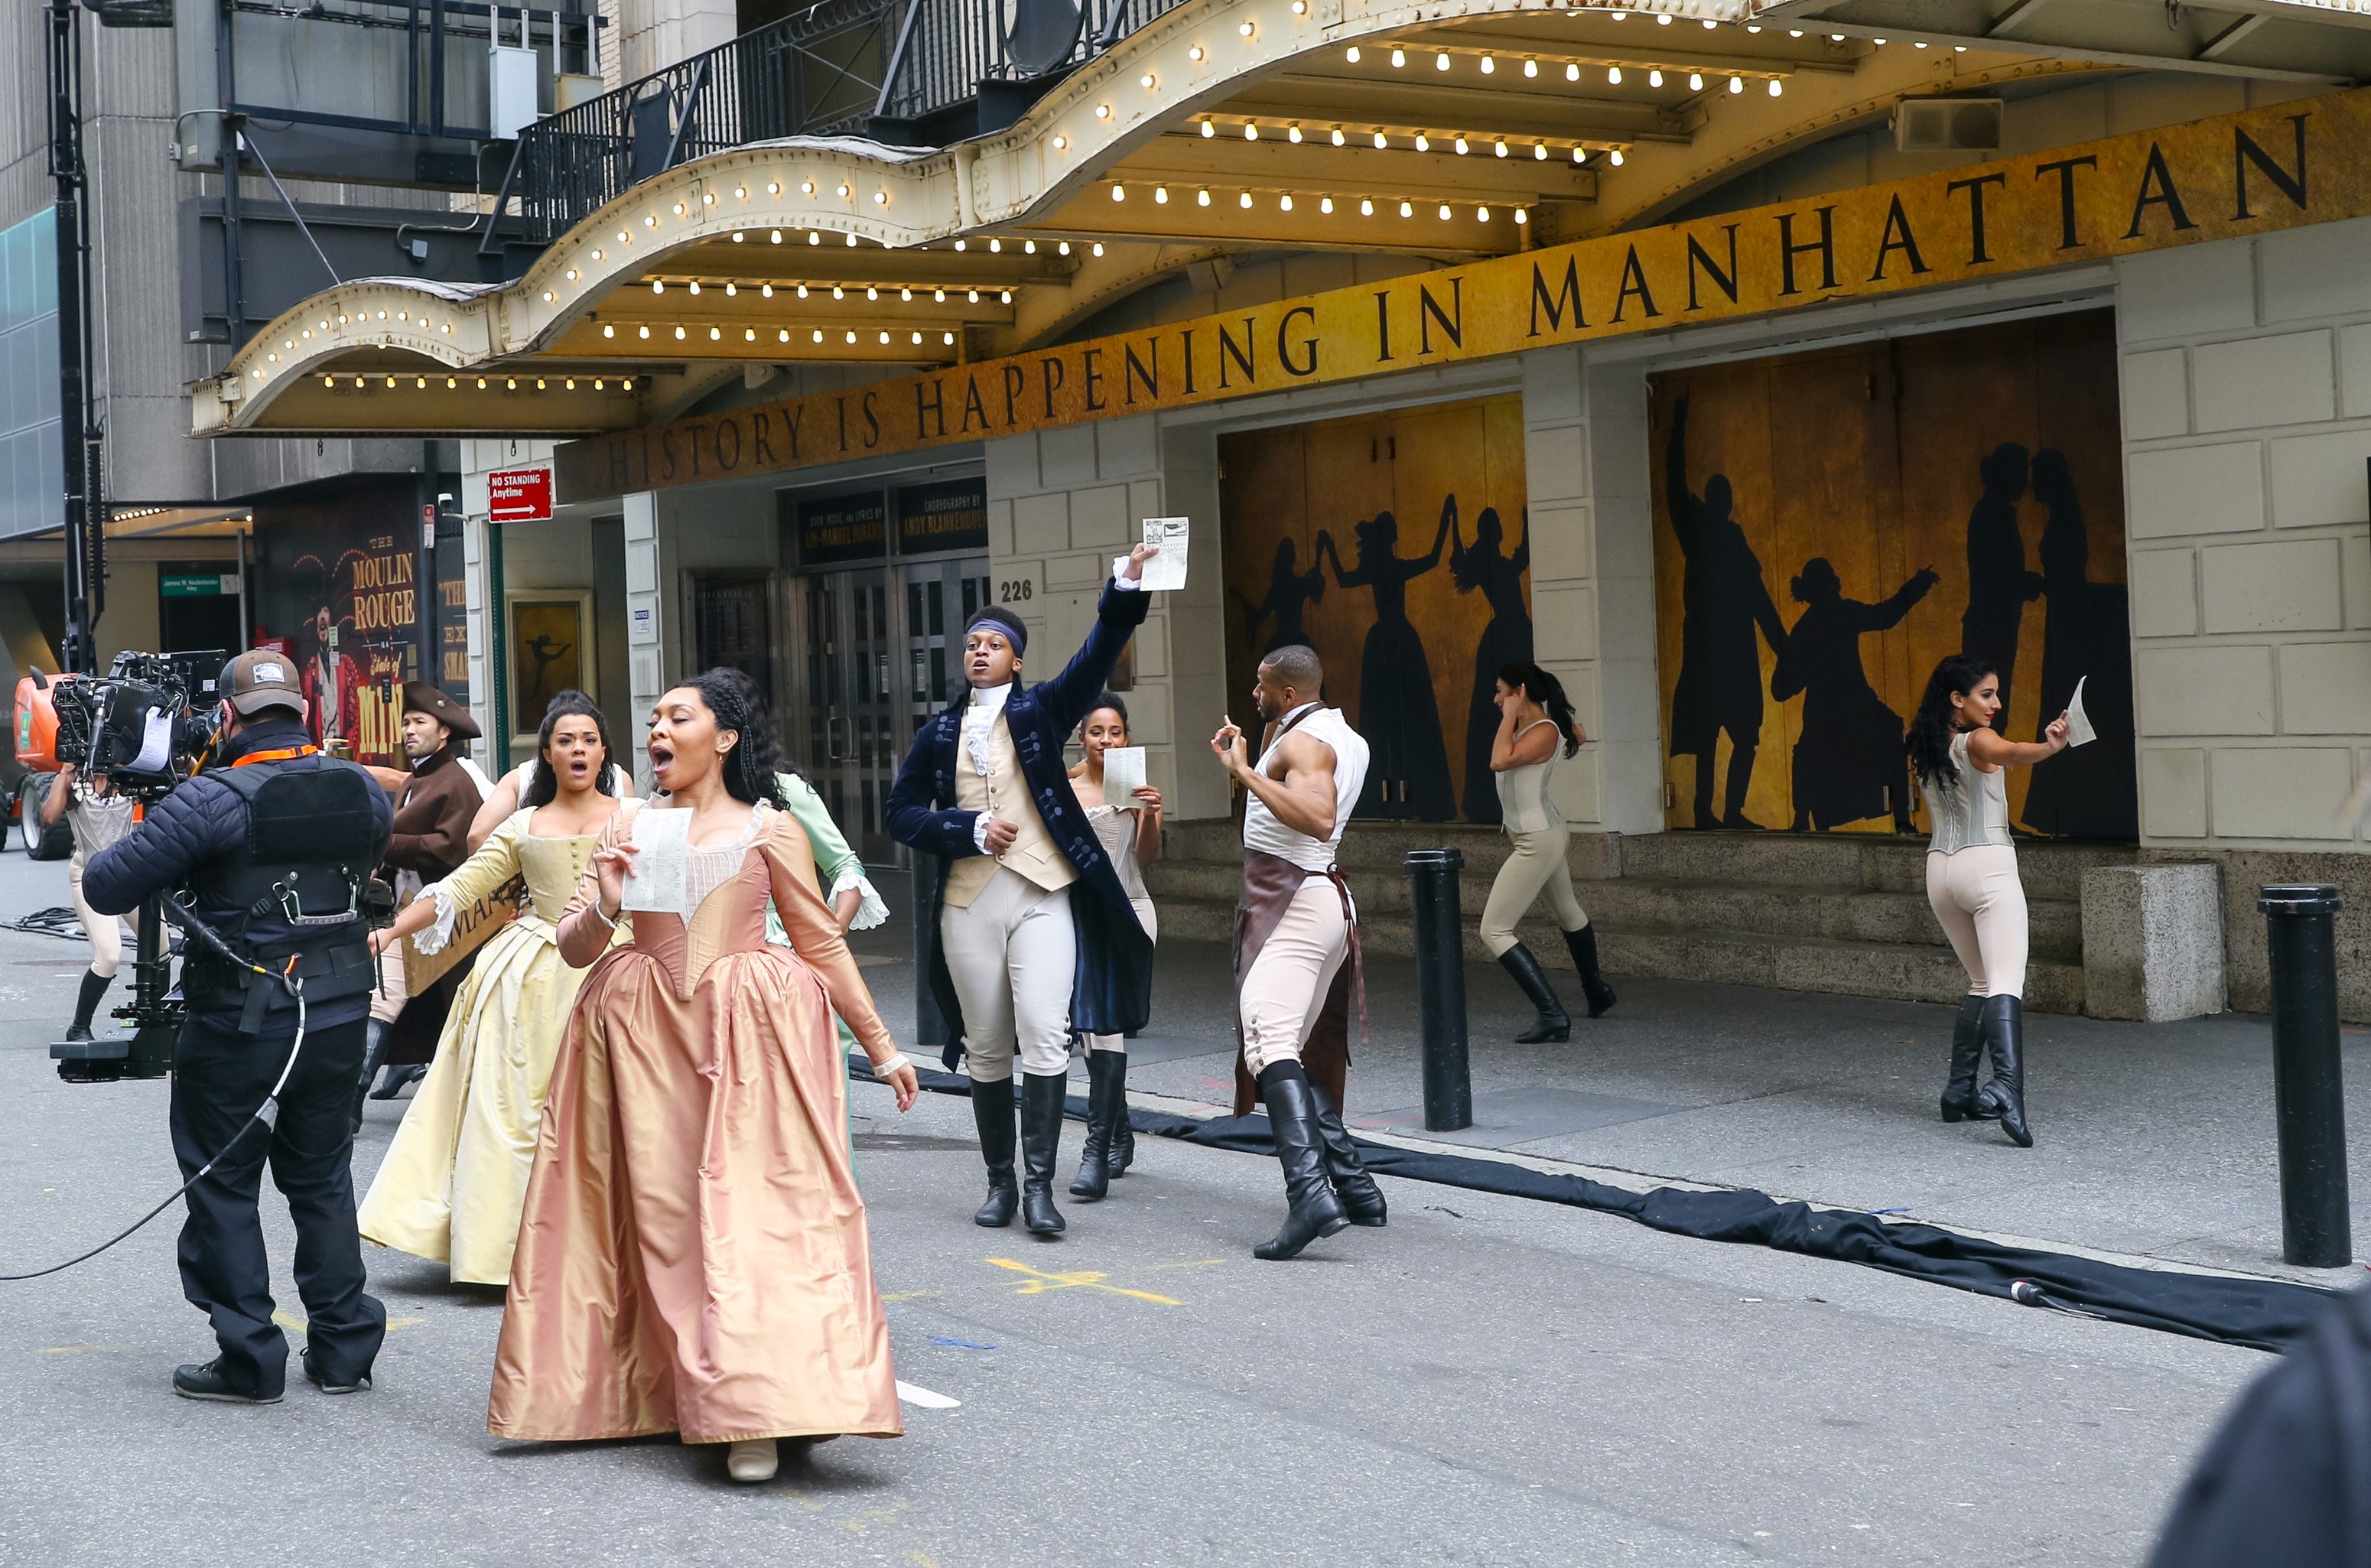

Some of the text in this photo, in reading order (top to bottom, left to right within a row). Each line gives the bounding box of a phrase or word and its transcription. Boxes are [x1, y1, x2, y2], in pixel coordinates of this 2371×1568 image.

[607, 112, 2313, 490] HISTORY IS HAPPENING IN MANHATTAN
[492, 474, 541, 486] NO STANDING
[492, 488, 523, 499] Anytime
[924, 494, 981, 512] CHOREOGRAPHY BY
[905, 515, 925, 536] ANDY
[369, 536, 393, 548] THE
[352, 552, 413, 590] MOULIN
[1001, 579, 1032, 603] 226
[354, 590, 415, 630] ROUGE
